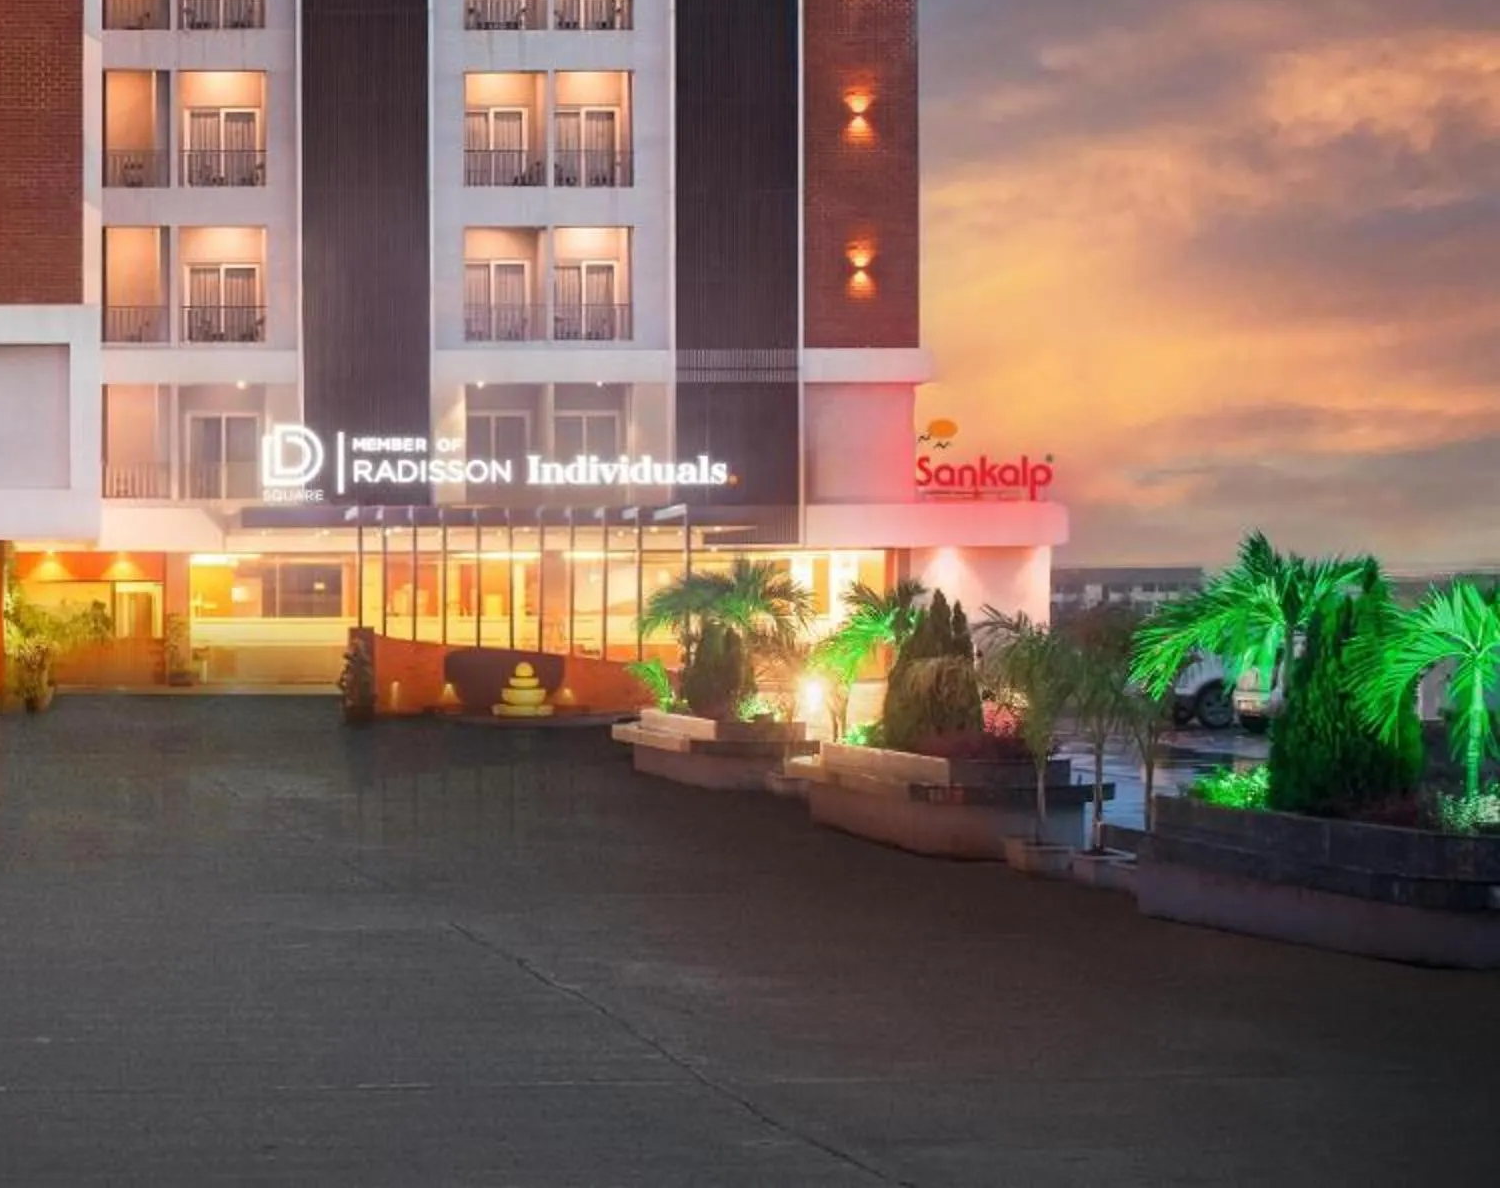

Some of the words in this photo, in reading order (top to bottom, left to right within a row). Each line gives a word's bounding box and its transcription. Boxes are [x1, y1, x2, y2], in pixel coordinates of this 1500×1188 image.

[352, 437, 428, 453] MEMBER
[436, 437, 464, 453] OF
[352, 459, 513, 484] RADISSON
[915, 454, 1053, 501] Sankalp
[262, 489, 325, 503] SQUARE
